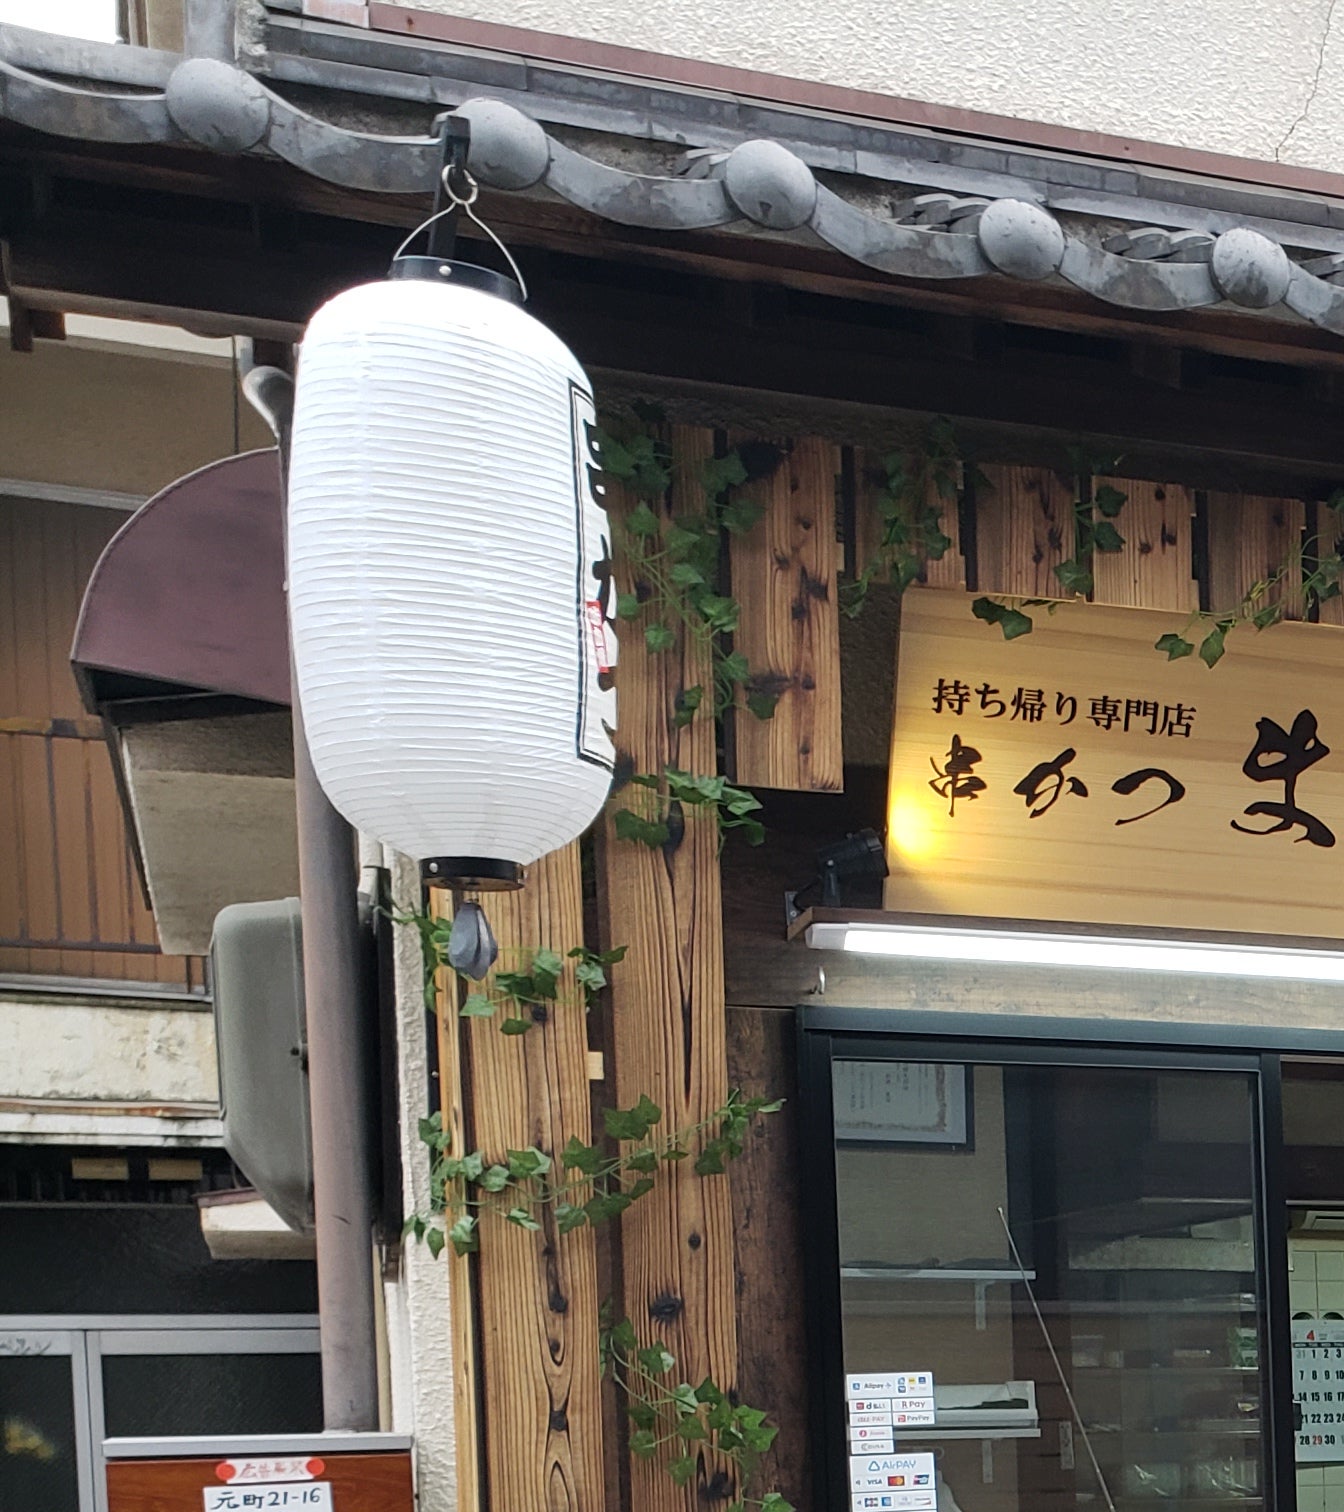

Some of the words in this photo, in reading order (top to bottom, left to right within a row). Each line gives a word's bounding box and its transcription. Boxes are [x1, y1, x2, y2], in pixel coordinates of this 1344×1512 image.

[932, 678, 1197, 737] 持ち帰り専門店
[927, 734, 1186, 826] 串かつ
[1307, 1330, 1315, 1341] 4
[211, 1487, 322, 1510] 元町21-16
